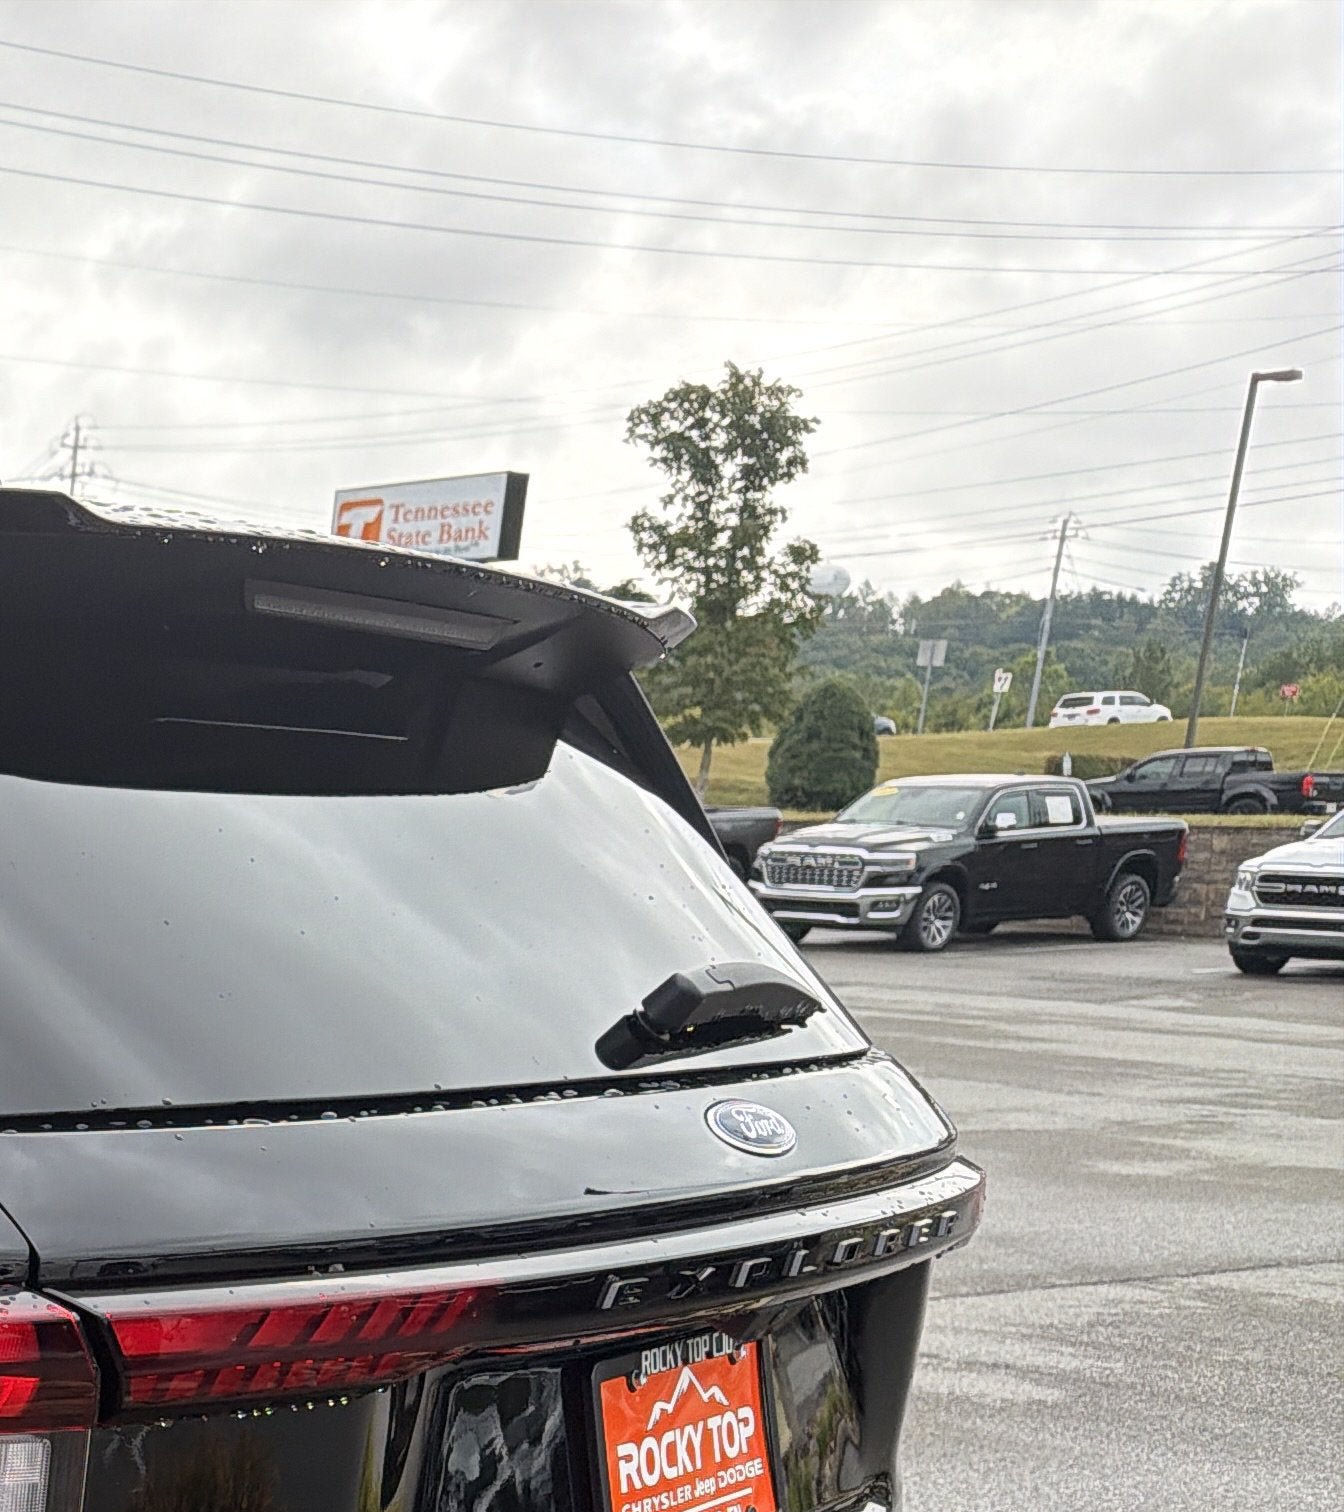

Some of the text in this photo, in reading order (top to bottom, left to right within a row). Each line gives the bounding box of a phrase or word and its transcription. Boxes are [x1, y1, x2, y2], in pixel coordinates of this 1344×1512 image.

[389, 499, 495, 524] Tennessee
[387, 520, 490, 546] State Bank
[597, 1210, 959, 1310] EXPLORER
[641, 1339, 685, 1376] ROCKY
[686, 1334, 710, 1364] TOP
[616, 1406, 755, 1494] ROCKY TOP
[694, 1476, 716, 1498] Jeep
[716, 1457, 764, 1488] DODGE
